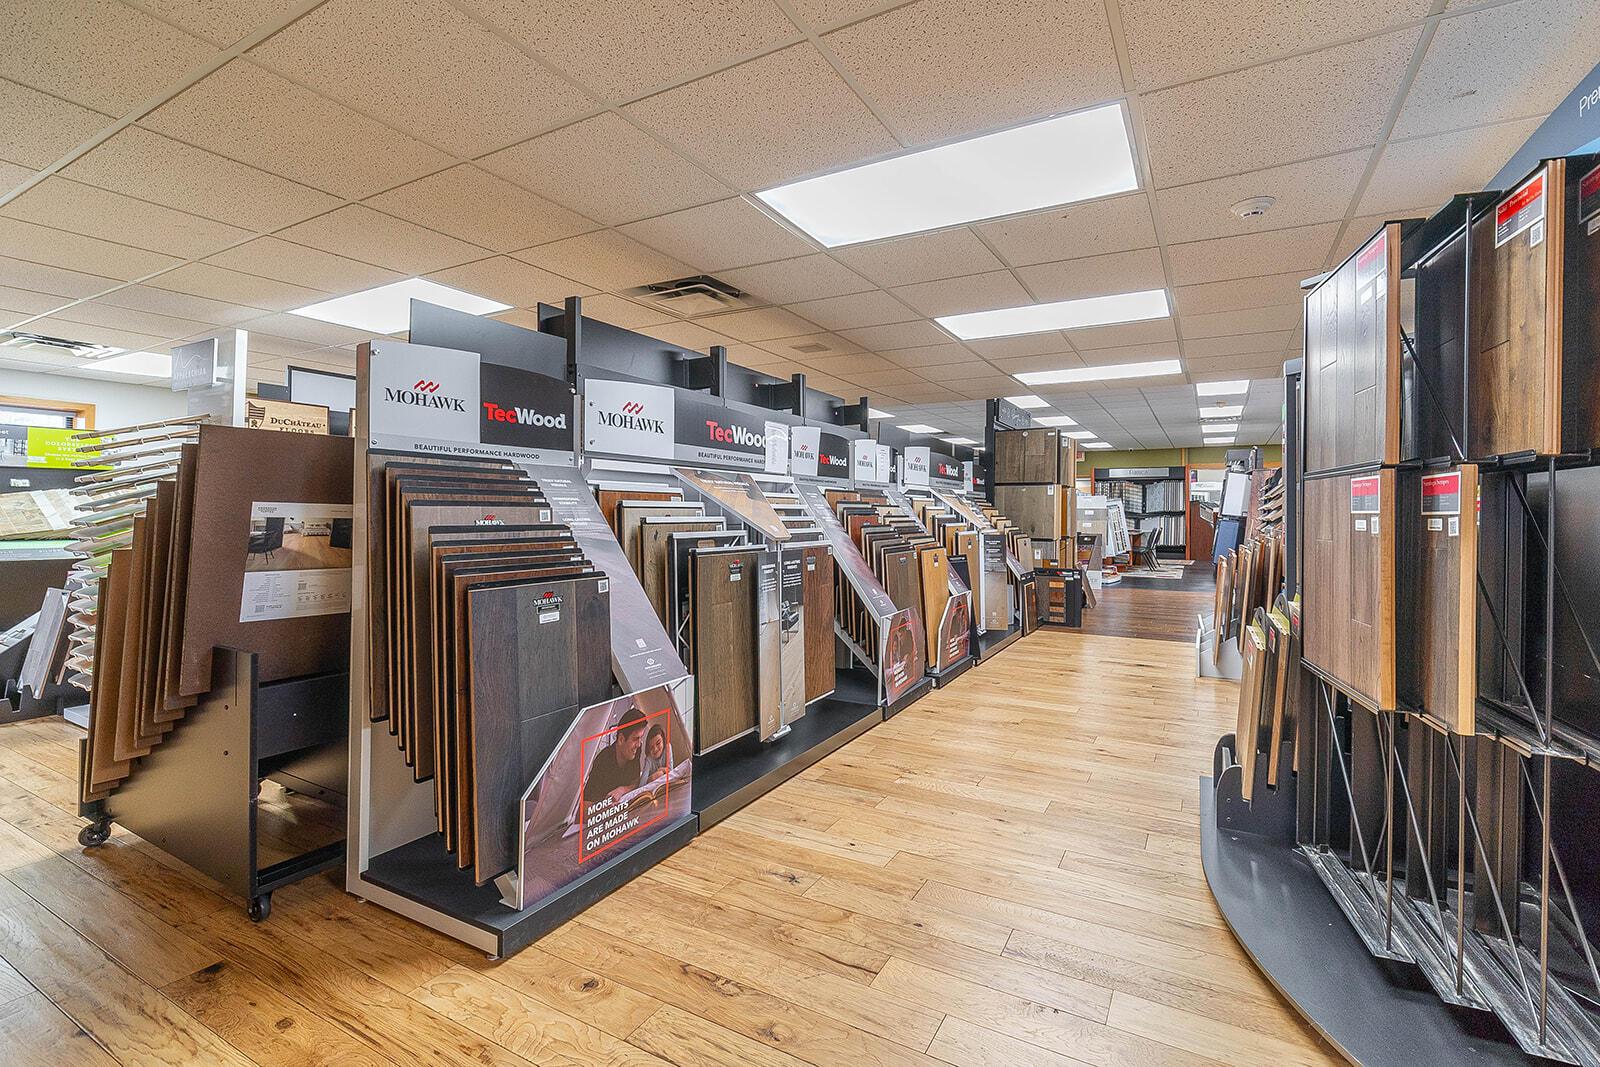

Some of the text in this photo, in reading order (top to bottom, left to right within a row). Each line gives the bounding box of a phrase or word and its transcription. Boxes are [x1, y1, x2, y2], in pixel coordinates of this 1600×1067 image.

[384, 387, 466, 412] MOHAWK
[483, 401, 567, 430] TecWood
[598, 411, 665, 434] MOHAWK
[705, 420, 766, 449] TecWoo
[414, 443, 541, 460] BEAUTIFUL PERFORMANCE HARDWOOD
[697, 451, 723, 460] BEAUTIFUL
[819, 453, 847, 467] TecWood
[587, 796, 613, 816] MORE
[587, 800, 629, 828] MOMENTS
[586, 811, 629, 840] ARE MADE
[586, 816, 640, 851] ON MOHAWK
